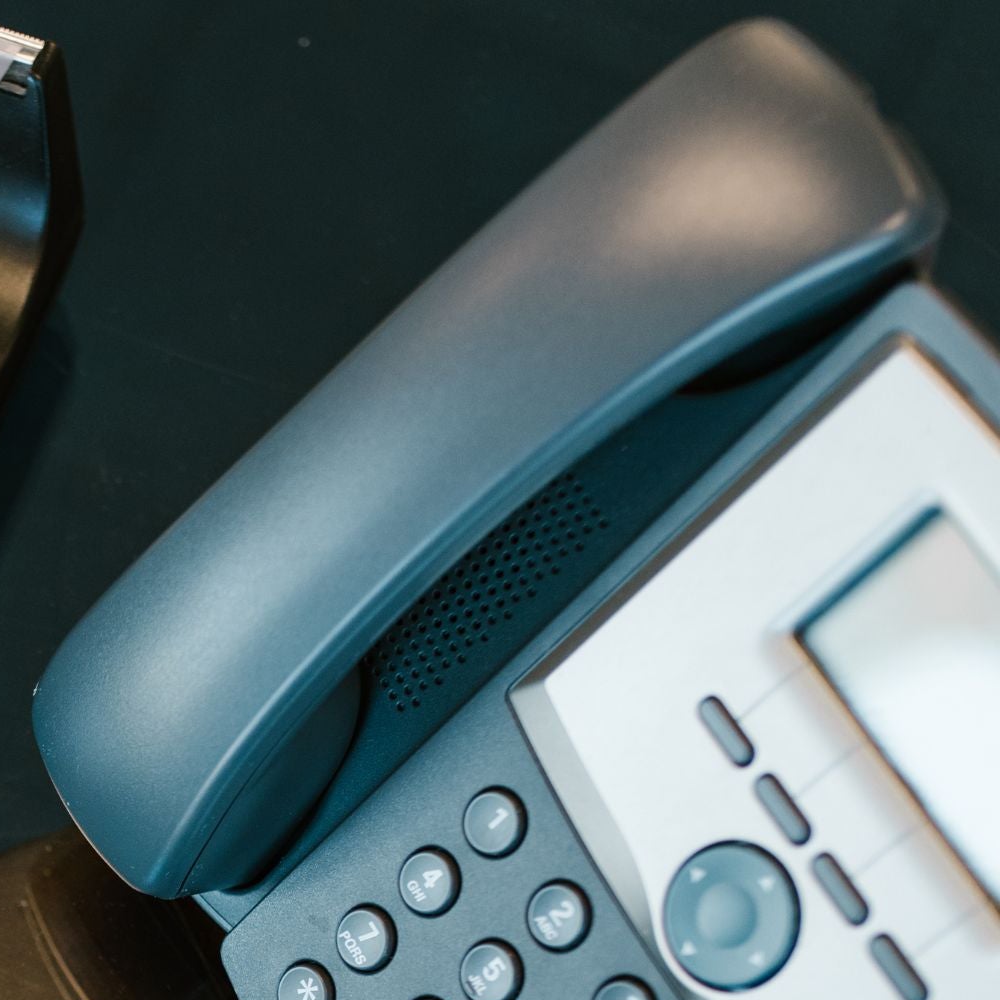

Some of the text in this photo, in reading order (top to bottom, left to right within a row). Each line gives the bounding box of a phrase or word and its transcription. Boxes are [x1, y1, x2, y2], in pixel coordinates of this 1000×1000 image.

[488, 808, 508, 830] 1
[422, 869, 443, 889] 4
[407, 880, 427, 902] GHI
[549, 901, 575, 926] 2
[358, 921, 381, 942] 7
[338, 930, 367, 965] PQRS
[483, 956, 506, 982] 5
[467, 974, 487, 996] JKL
